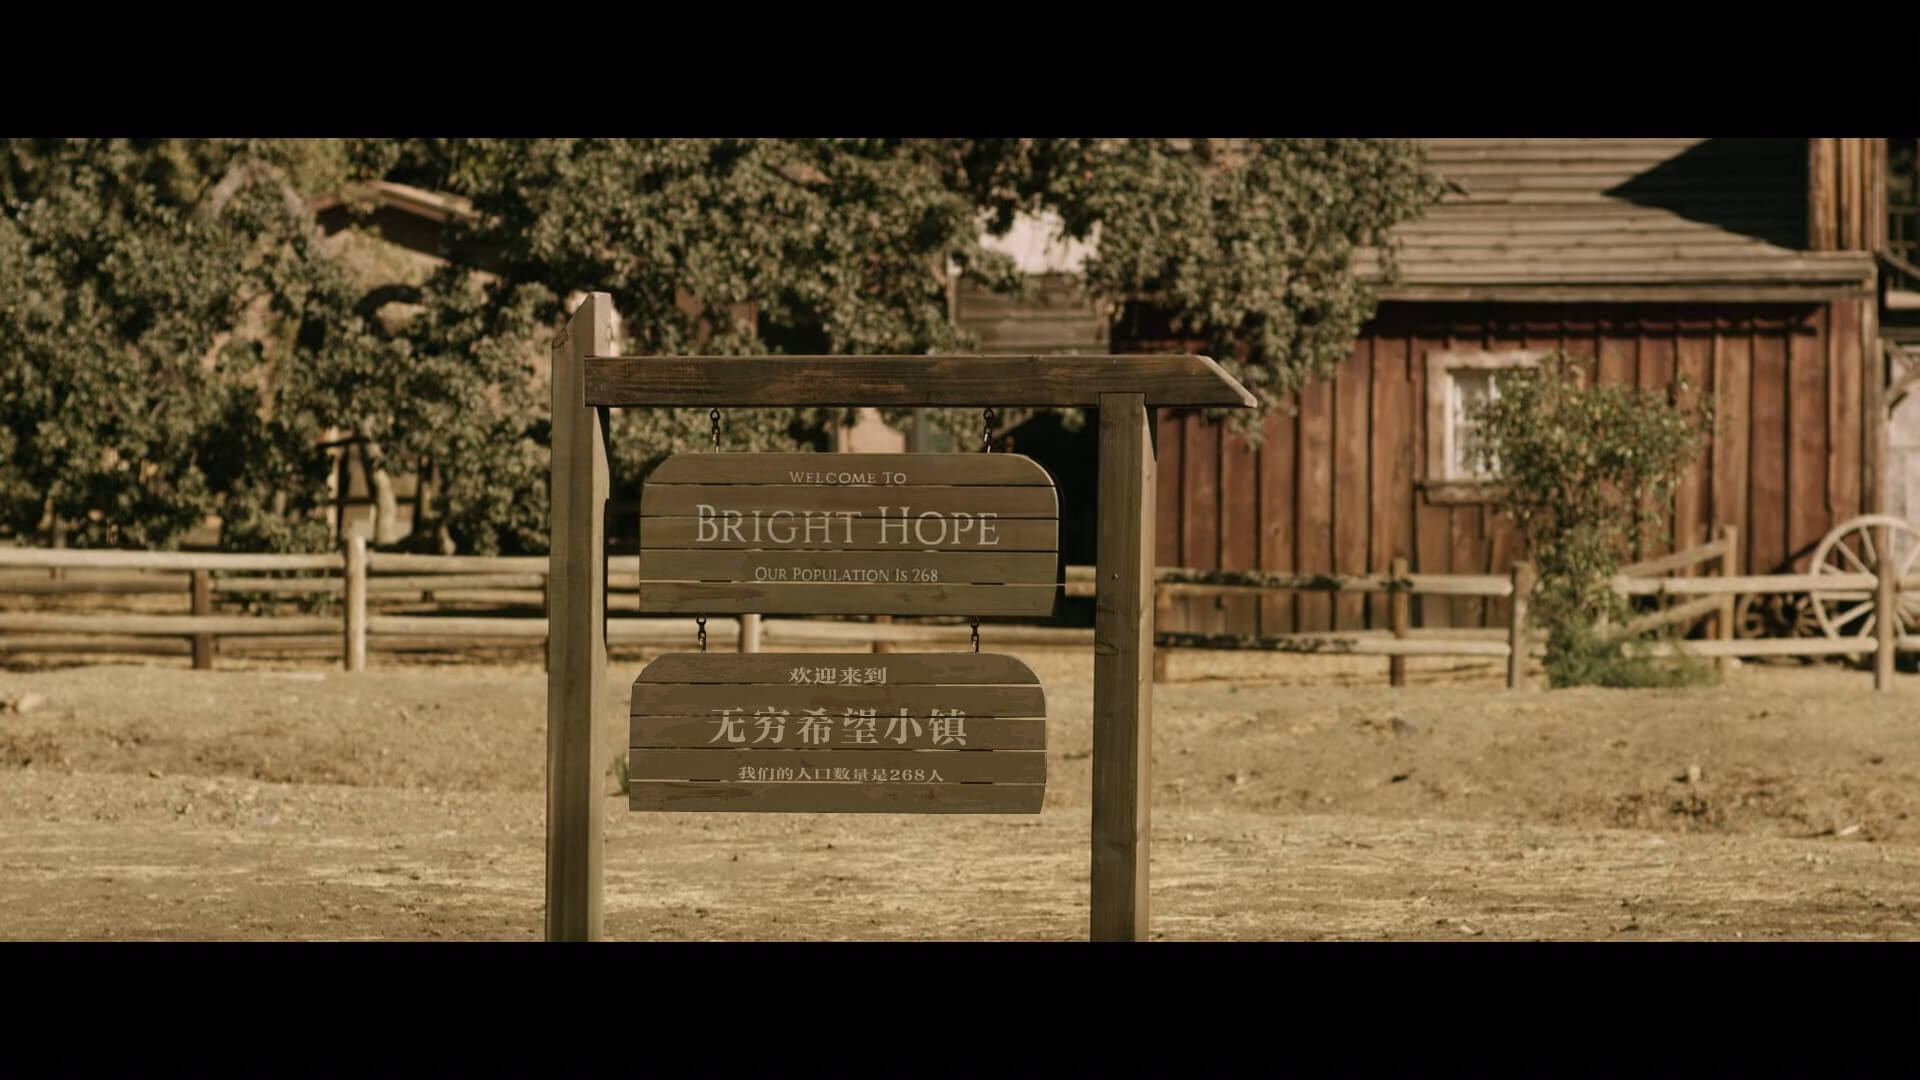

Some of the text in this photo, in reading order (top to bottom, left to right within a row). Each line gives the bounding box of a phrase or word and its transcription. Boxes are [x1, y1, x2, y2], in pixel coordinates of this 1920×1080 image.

[789, 471, 907, 486] WELCOME TO
[695, 504, 1001, 546] BRIGHT HOPE
[754, 566, 787, 581] OUR
[792, 567, 890, 582] POPULATION
[911, 568, 939, 583] 268
[788, 666, 888, 685] 欢迎来到
[707, 706, 969, 746] 无穷希望小镇
[738, 766, 945, 783] 我们的人口数量是268人
